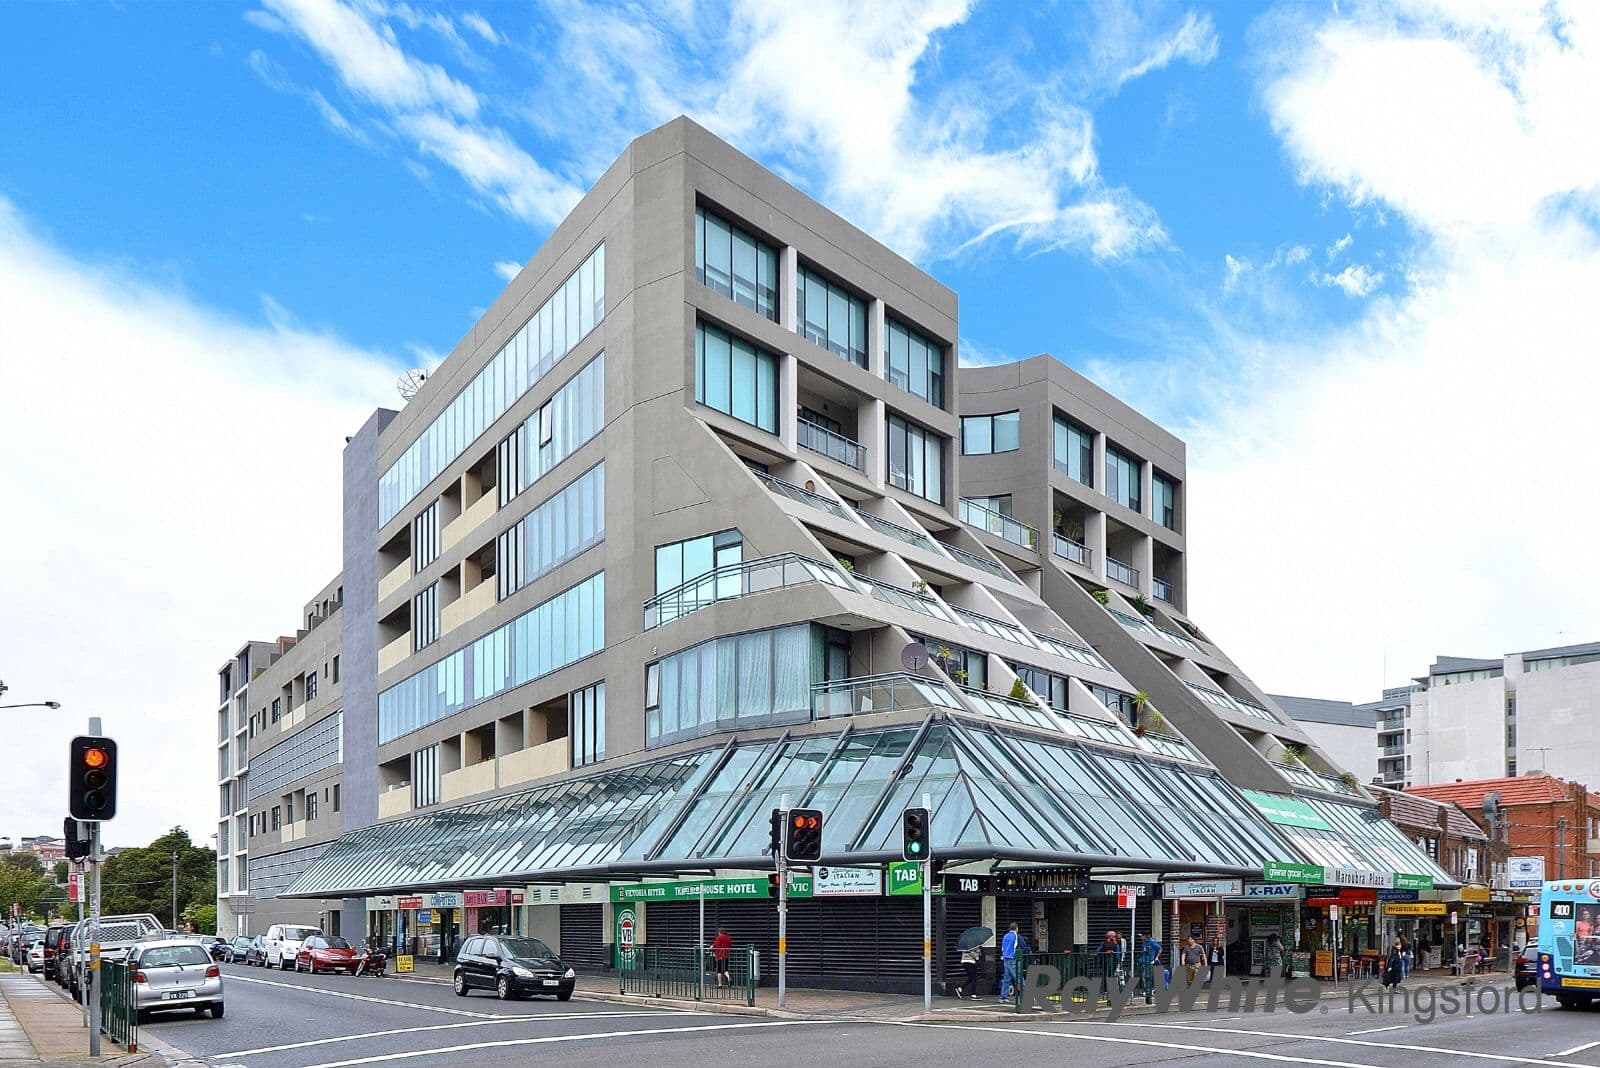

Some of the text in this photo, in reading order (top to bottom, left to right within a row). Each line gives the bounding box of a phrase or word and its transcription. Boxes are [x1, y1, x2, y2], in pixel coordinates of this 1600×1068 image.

[894, 869, 917, 882] TAB
[1335, 869, 1384, 886] Maroubra Plaza
[727, 883, 757, 894] HOTEL
[959, 878, 979, 892] TAB
[1103, 884, 1117, 896] VIP
[1249, 885, 1293, 896] X-RAY
[1554, 904, 1571, 916] 400
[622, 929, 632, 943] VB
